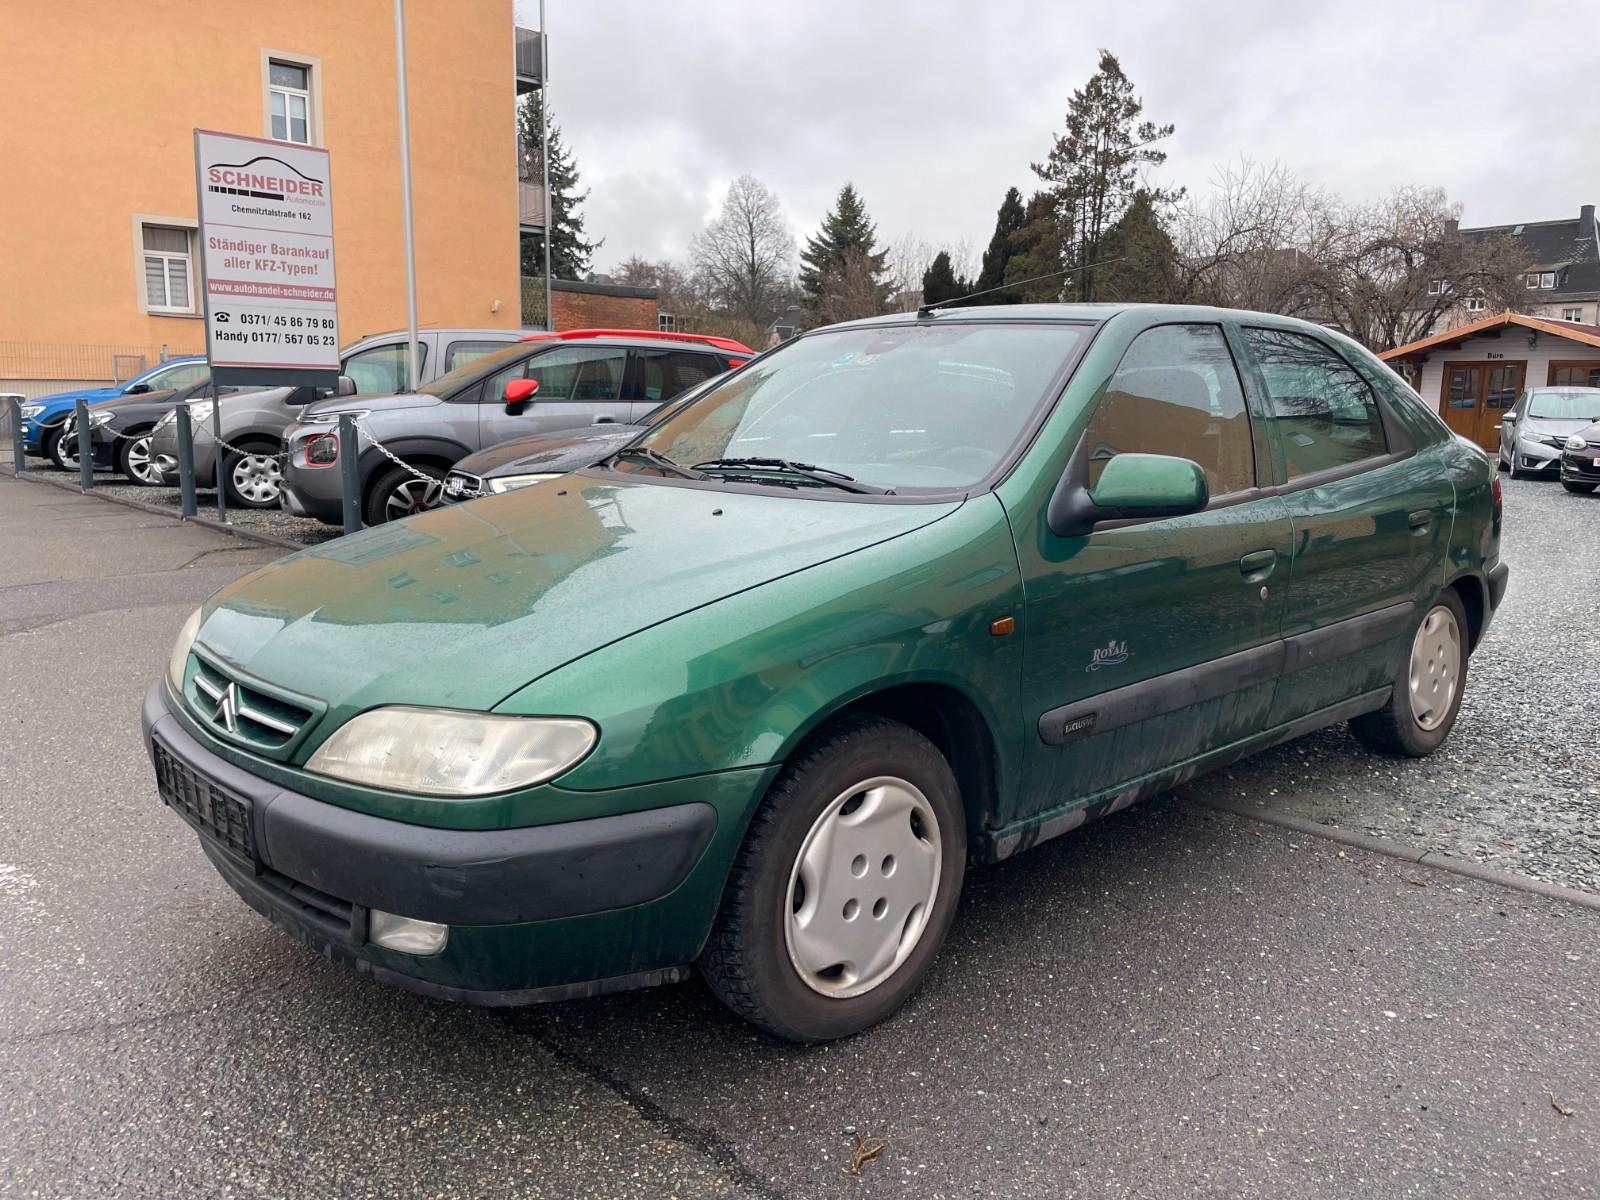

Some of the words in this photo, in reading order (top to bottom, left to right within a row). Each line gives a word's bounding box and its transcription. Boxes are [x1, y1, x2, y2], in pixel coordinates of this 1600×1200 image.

[209, 168, 324, 197] SCHNEIDER
[231, 204, 297, 219] Chemnitztalstraße
[298, 211, 312, 221] 162
[209, 236, 267, 256] Ständiger
[270, 243, 330, 260] Barankauf
[223, 257, 251, 270] aller
[254, 259, 318, 276] KFZ-Typen!
[209, 282, 334, 300] www.autohandel-schneider.de
[240, 313, 271, 327] 0371/
[274, 315, 287, 327] 45
[290, 316, 303, 328] 86
[305, 317, 319, 329] 79
[322, 318, 334, 330] 80
[215, 329, 249, 344] Handy
[251, 332, 282, 344] 0177/
[284, 333, 303, 345] 567
[307, 334, 319, 346] 05
[322, 335, 335, 347] 23
[1091, 641, 1128, 662] ROYAL
